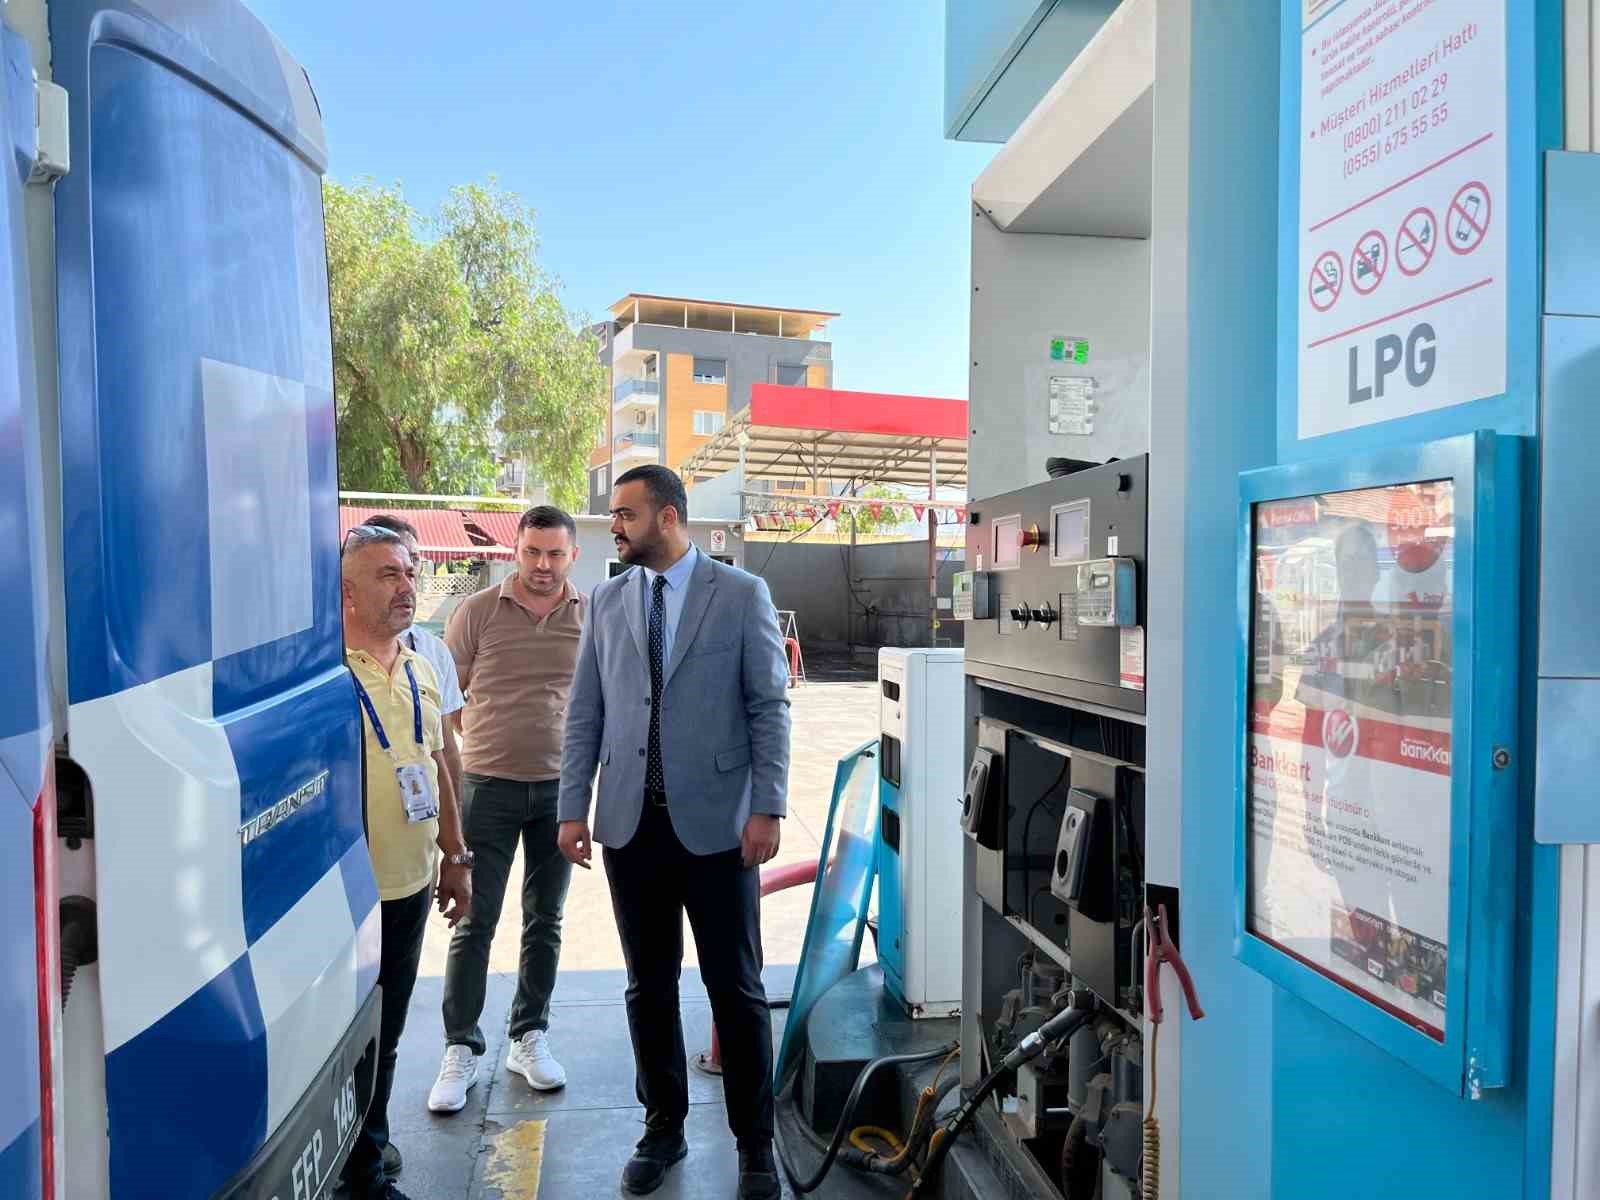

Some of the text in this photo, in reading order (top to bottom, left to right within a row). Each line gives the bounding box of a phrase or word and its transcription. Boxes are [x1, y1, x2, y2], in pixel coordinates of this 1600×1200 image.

[1320, 23, 1478, 137] Müşteri Hizmetleri Hattı
[1344, 72, 1448, 152] (0800) 211 02 29
[1344, 102, 1448, 178] (0555) 675 55 55
[1348, 322, 1436, 404] LPG
[1253, 746, 1311, 781] Bankkart
[334, 1076, 354, 1146] 146
